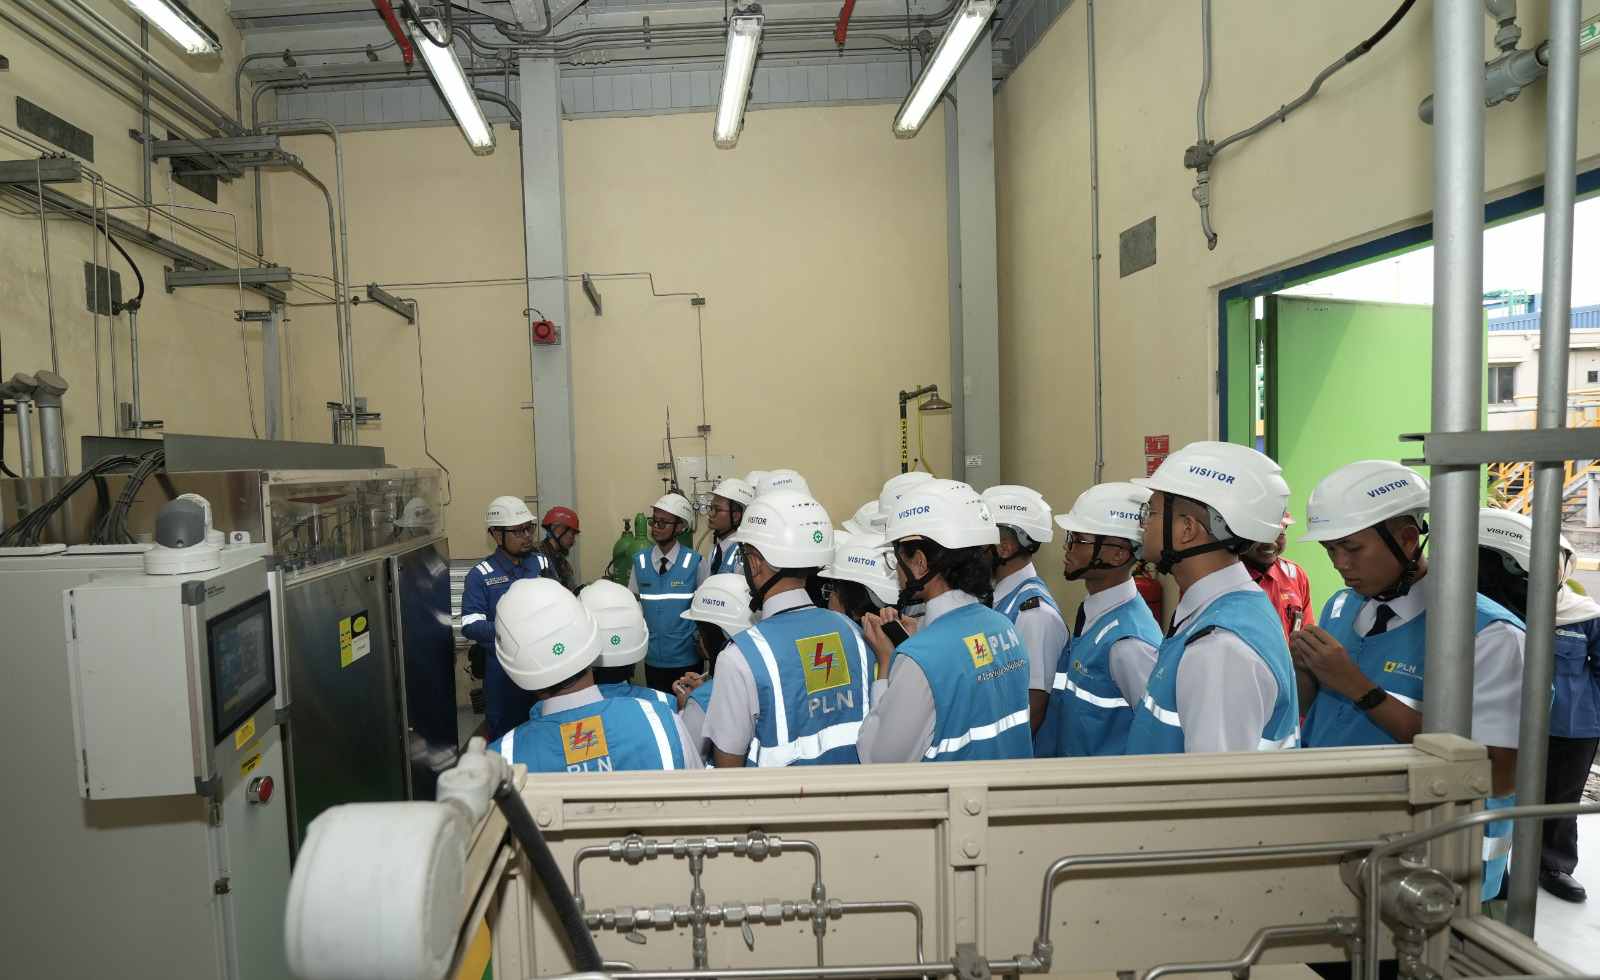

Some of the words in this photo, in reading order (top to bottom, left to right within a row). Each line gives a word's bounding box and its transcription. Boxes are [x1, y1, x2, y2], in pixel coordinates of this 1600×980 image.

[1190, 465, 1236, 485] VISITOR
[1367, 479, 1409, 498] VISITOR
[898, 505, 930, 519] VISITOR
[999, 504, 1027, 512] VISITOR
[1110, 510, 1141, 521] VISITO
[1486, 527, 1524, 540] VISITOR
[848, 556, 876, 567] VISITOR
[702, 597, 726, 607] VISITOR
[988, 627, 1020, 656] PLN
[1397, 662, 1416, 673] PLN
[808, 689, 854, 718] PLN
